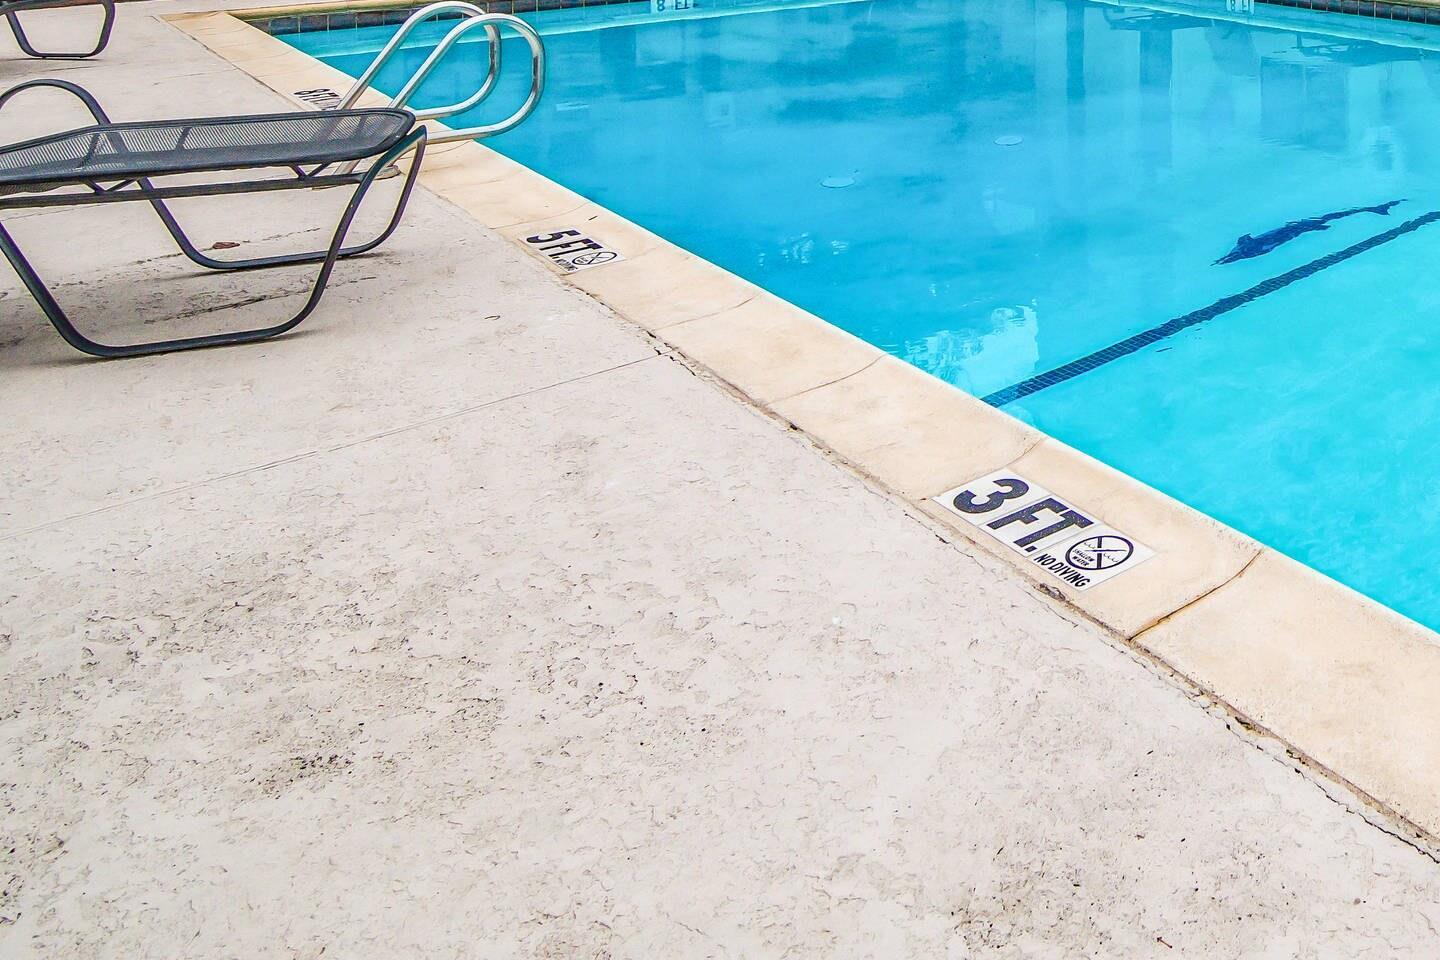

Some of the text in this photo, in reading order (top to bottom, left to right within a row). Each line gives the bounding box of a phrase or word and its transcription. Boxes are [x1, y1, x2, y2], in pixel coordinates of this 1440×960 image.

[526, 229, 582, 244] 5
[953, 478, 1030, 514] 3
[1072, 548, 1096, 562] SHALLOW
[1072, 555, 1090, 567] WATER
[1033, 553, 1091, 587] NO DIVING
